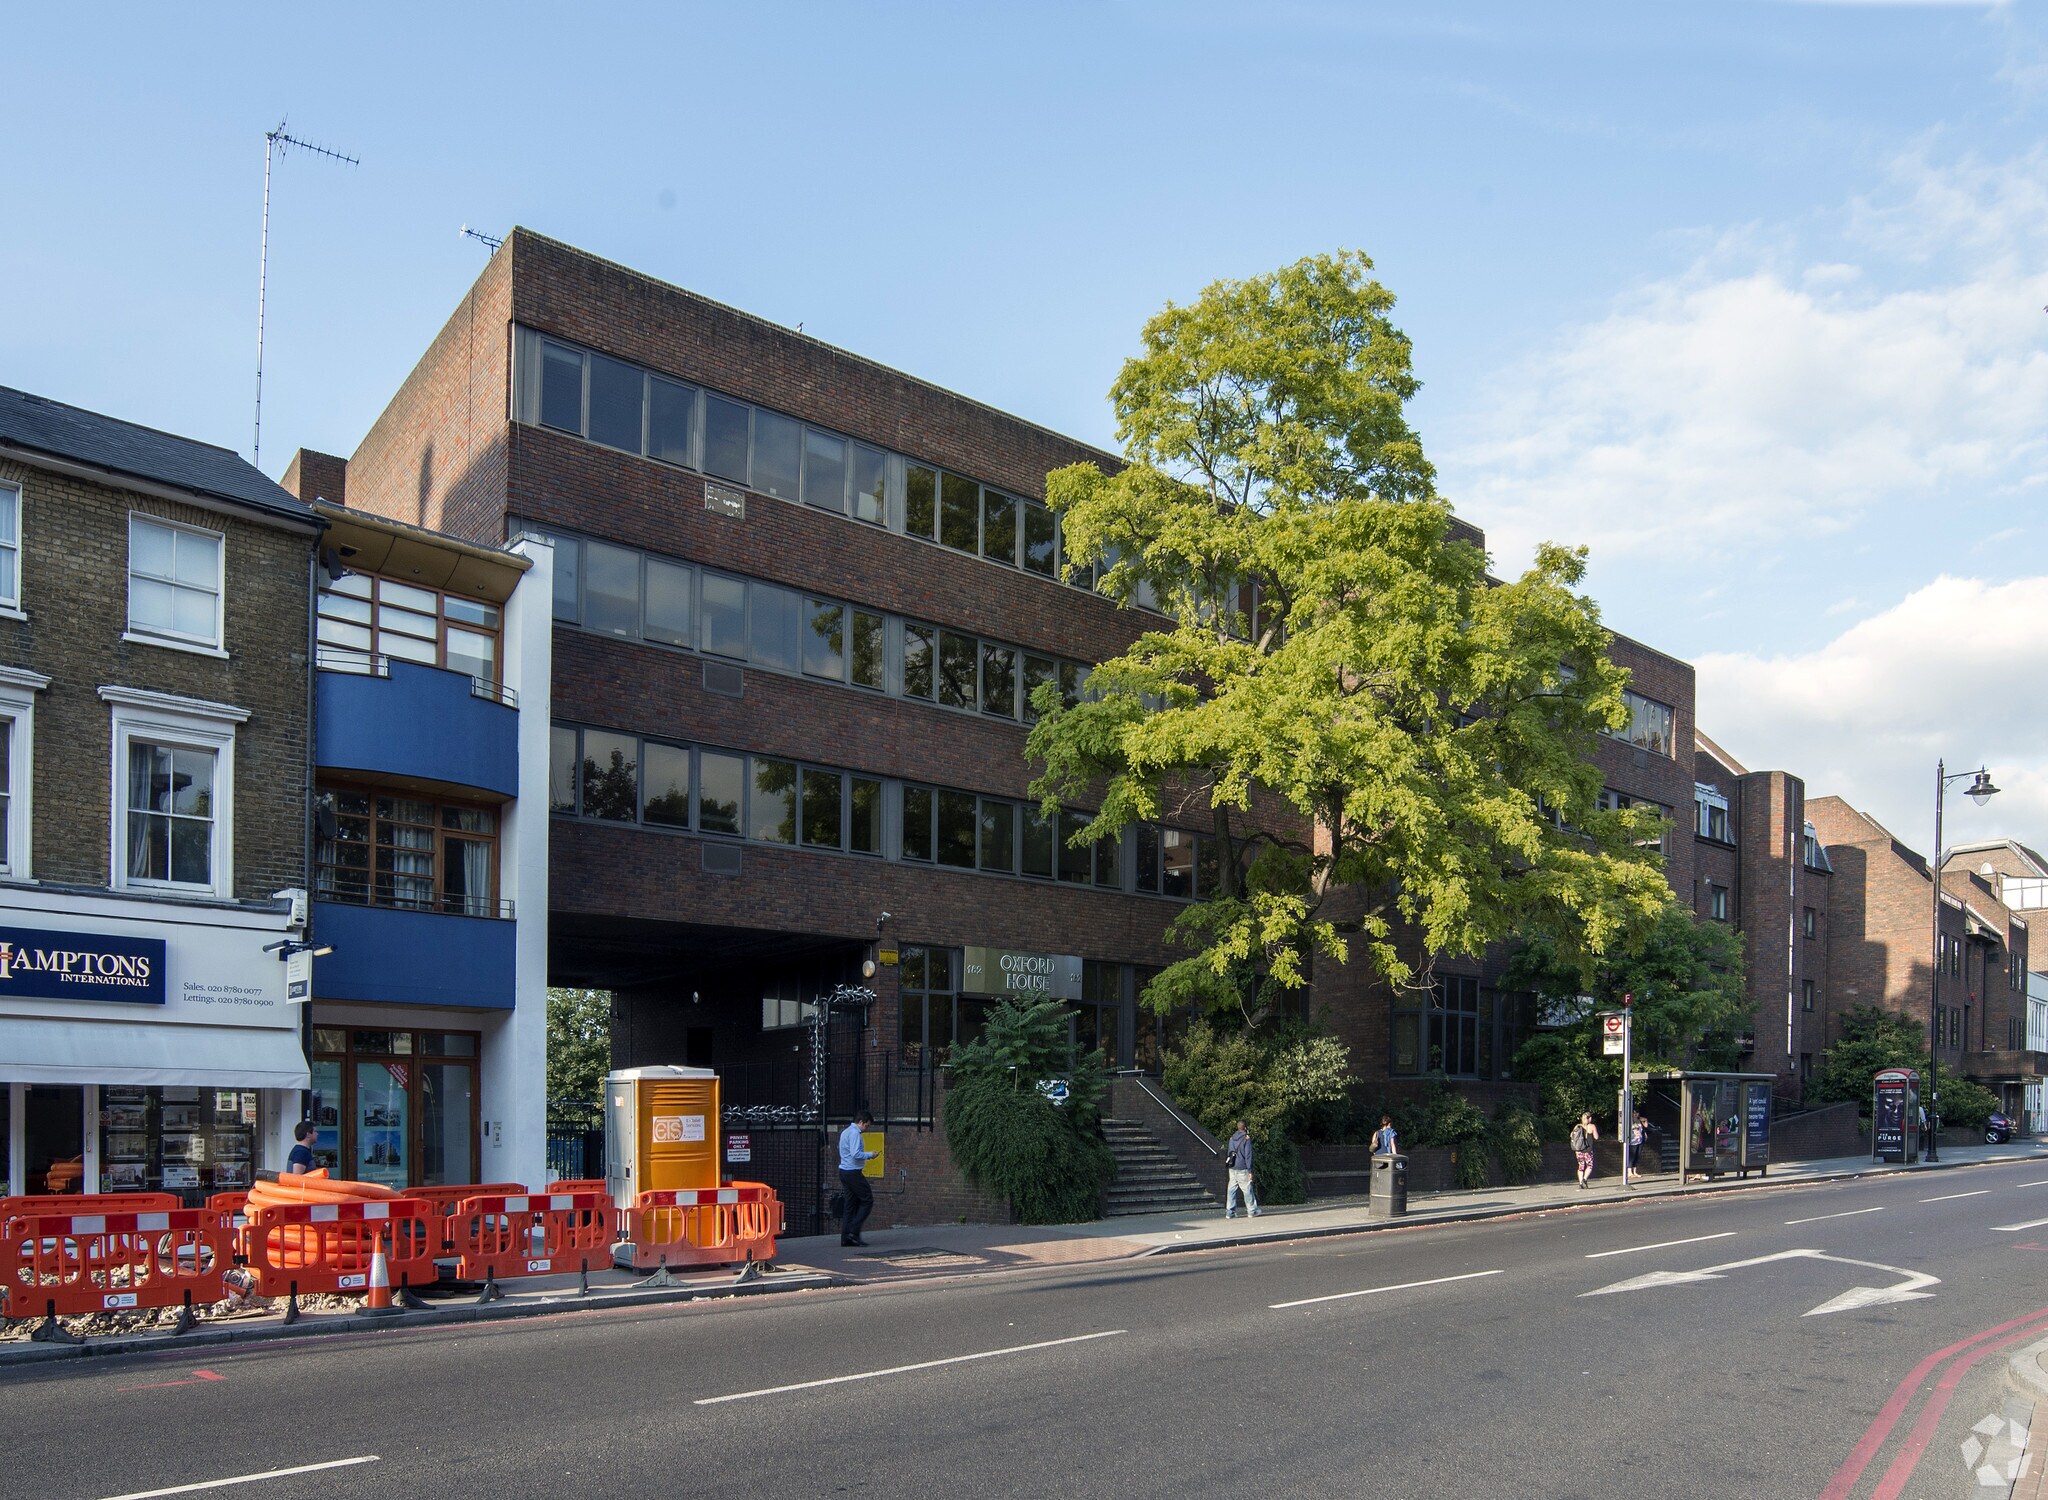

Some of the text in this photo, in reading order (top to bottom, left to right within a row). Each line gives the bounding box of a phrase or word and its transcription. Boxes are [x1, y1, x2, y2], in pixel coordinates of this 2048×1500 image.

[1000, 954, 1056, 974] OXFORD
[60, 973, 150, 987] INTERNATIONAL
[1006, 973, 1050, 992] HOUSE
[183, 982, 206, 991] Sales.
[223, 985, 243, 994] 8780
[243, 988, 263, 996] 0077
[183, 993, 217, 1004] Lettings.
[233, 997, 253, 1005] 8780
[1625, 994, 1631, 1002] F
